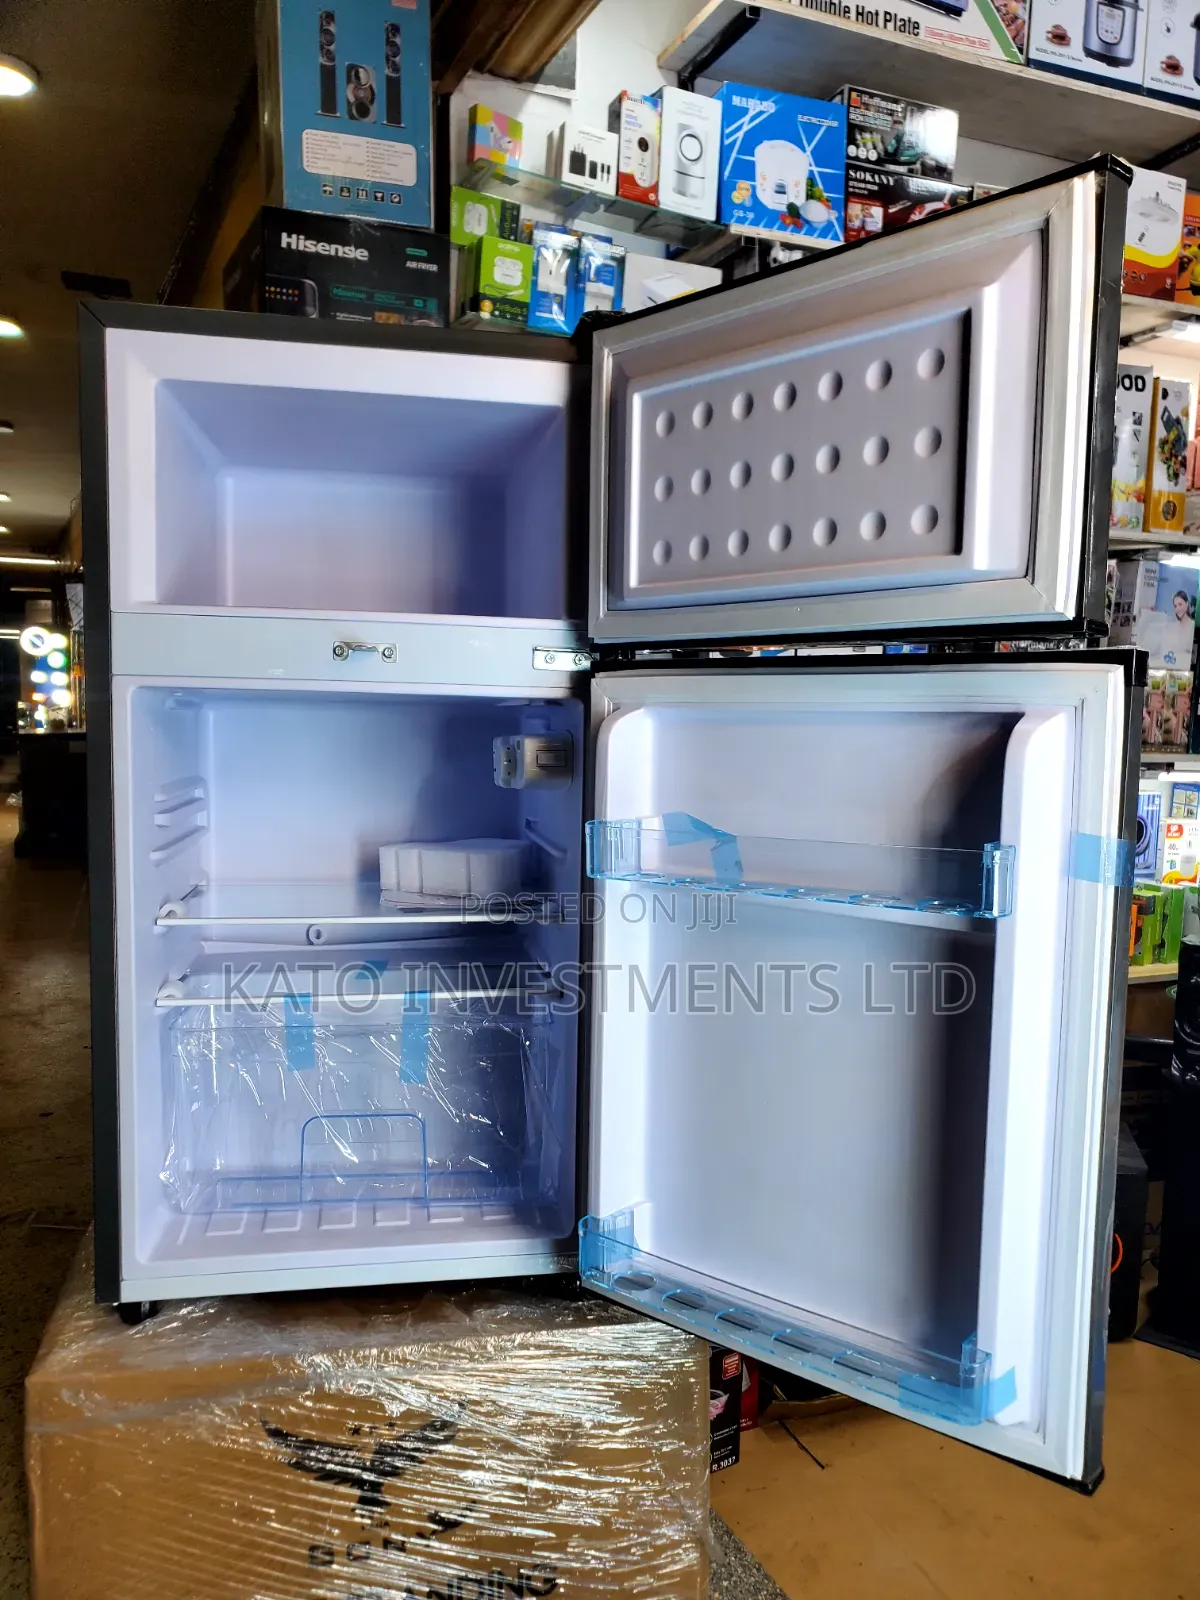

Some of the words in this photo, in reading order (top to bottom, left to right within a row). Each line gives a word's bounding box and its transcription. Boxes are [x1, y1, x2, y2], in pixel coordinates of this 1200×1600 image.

[856, 4, 880, 28] Hot
[884, 11, 921, 37] Plate
[848, 169, 896, 186] SOKANY
[281, 232, 369, 261] Hisense
